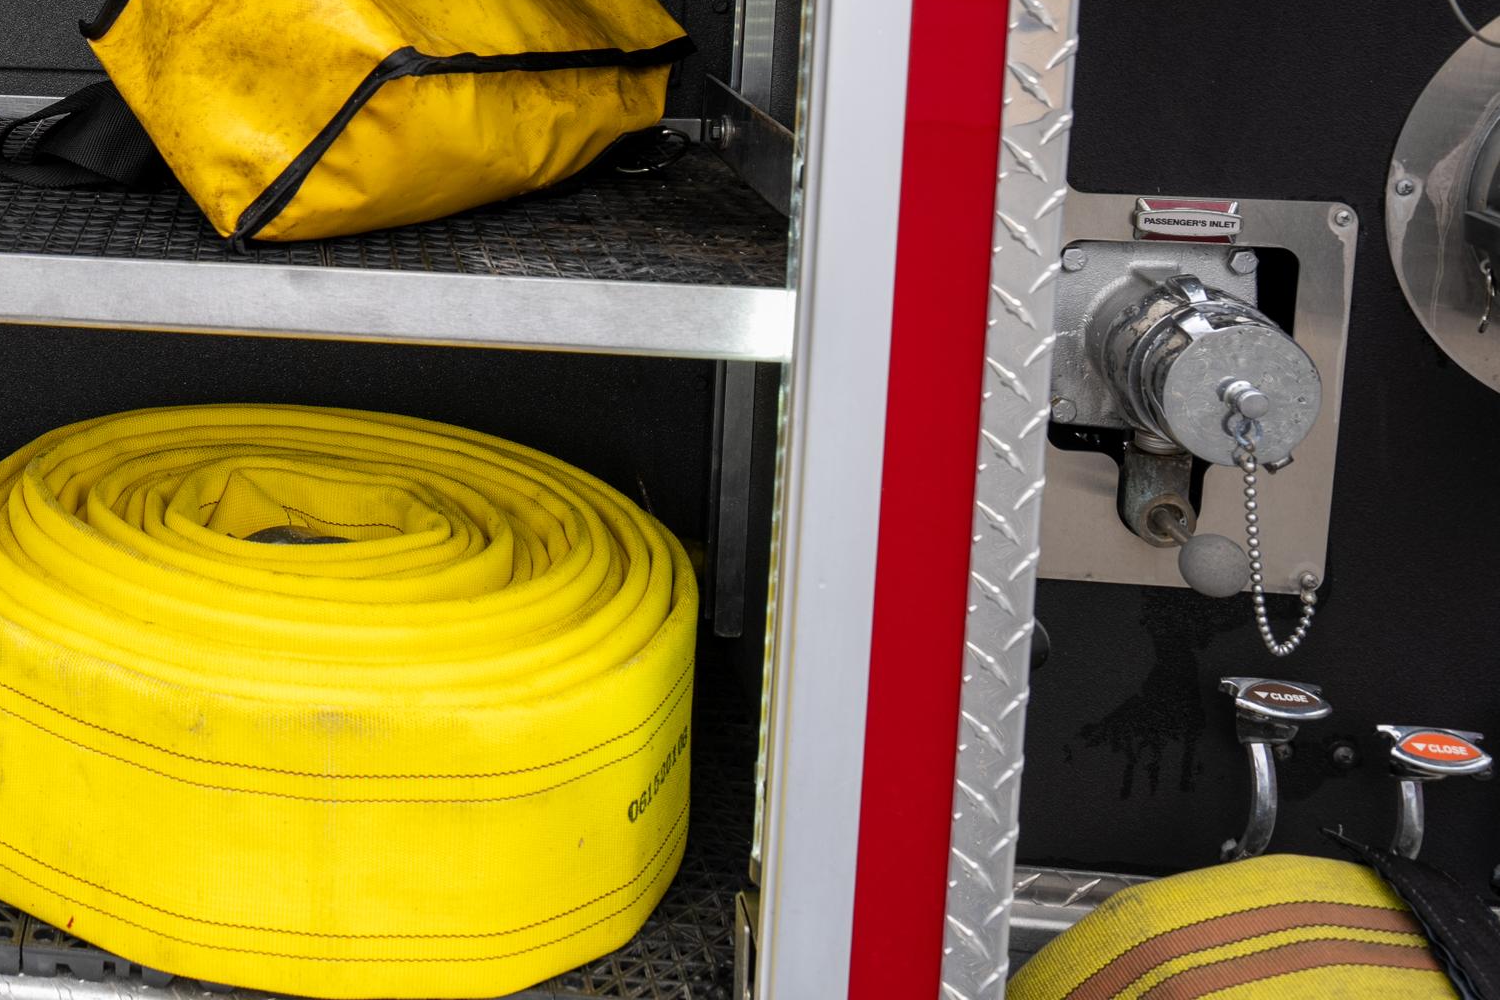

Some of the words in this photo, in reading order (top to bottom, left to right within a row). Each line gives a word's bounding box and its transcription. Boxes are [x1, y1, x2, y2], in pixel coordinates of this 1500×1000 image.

[1144, 218, 1207, 227] PASSENGER'S
[1270, 692, 1309, 702] CLOSE
[1428, 744, 1468, 756] CLOSE
